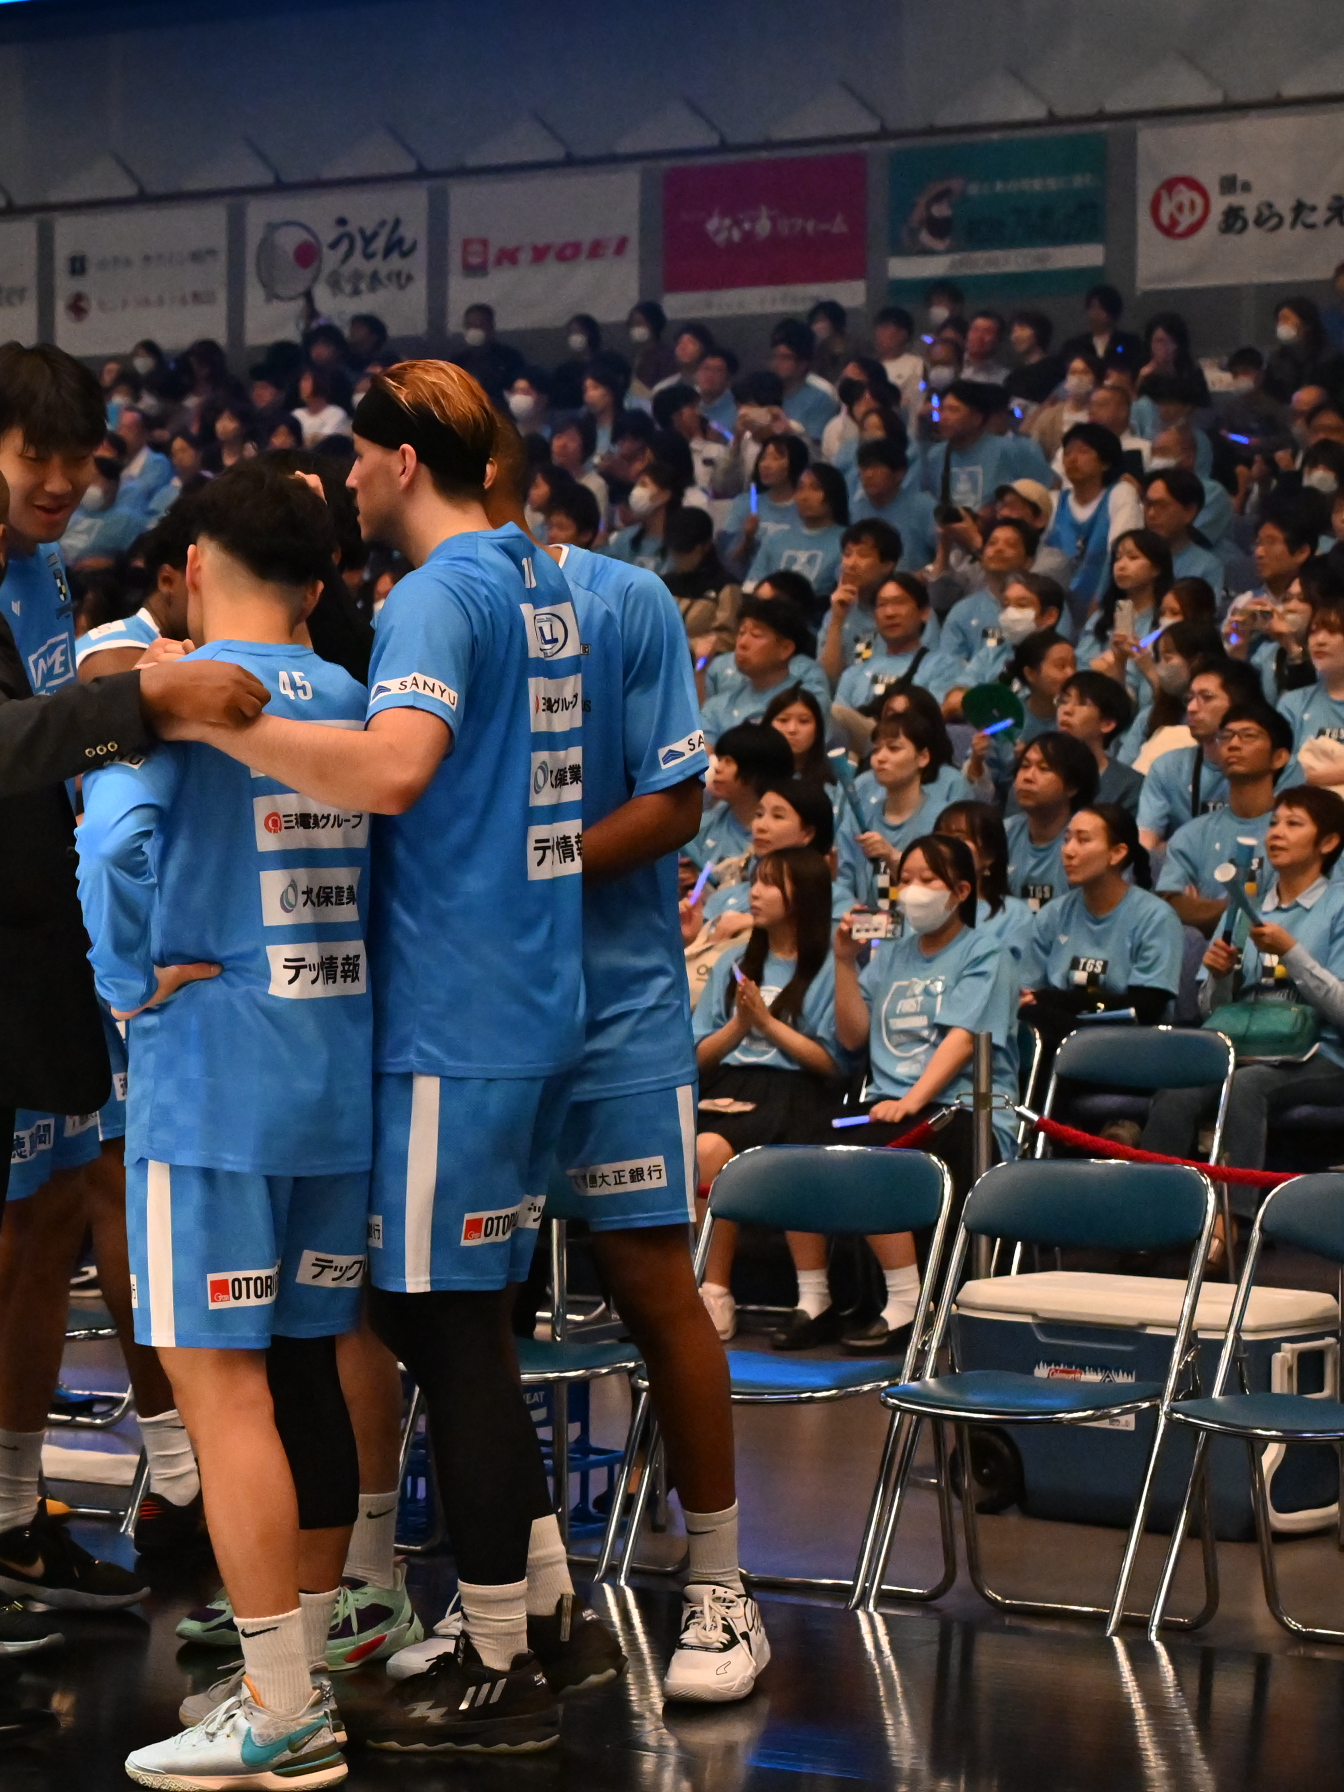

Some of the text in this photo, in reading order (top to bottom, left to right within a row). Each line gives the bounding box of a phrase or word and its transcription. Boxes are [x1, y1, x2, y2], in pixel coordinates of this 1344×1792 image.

[328, 216, 418, 266] うどん
[494, 234, 629, 267] KYOEI
[278, 670, 314, 701] 45
[398, 675, 457, 706] SANYU
[1078, 957, 1105, 974] TGS
